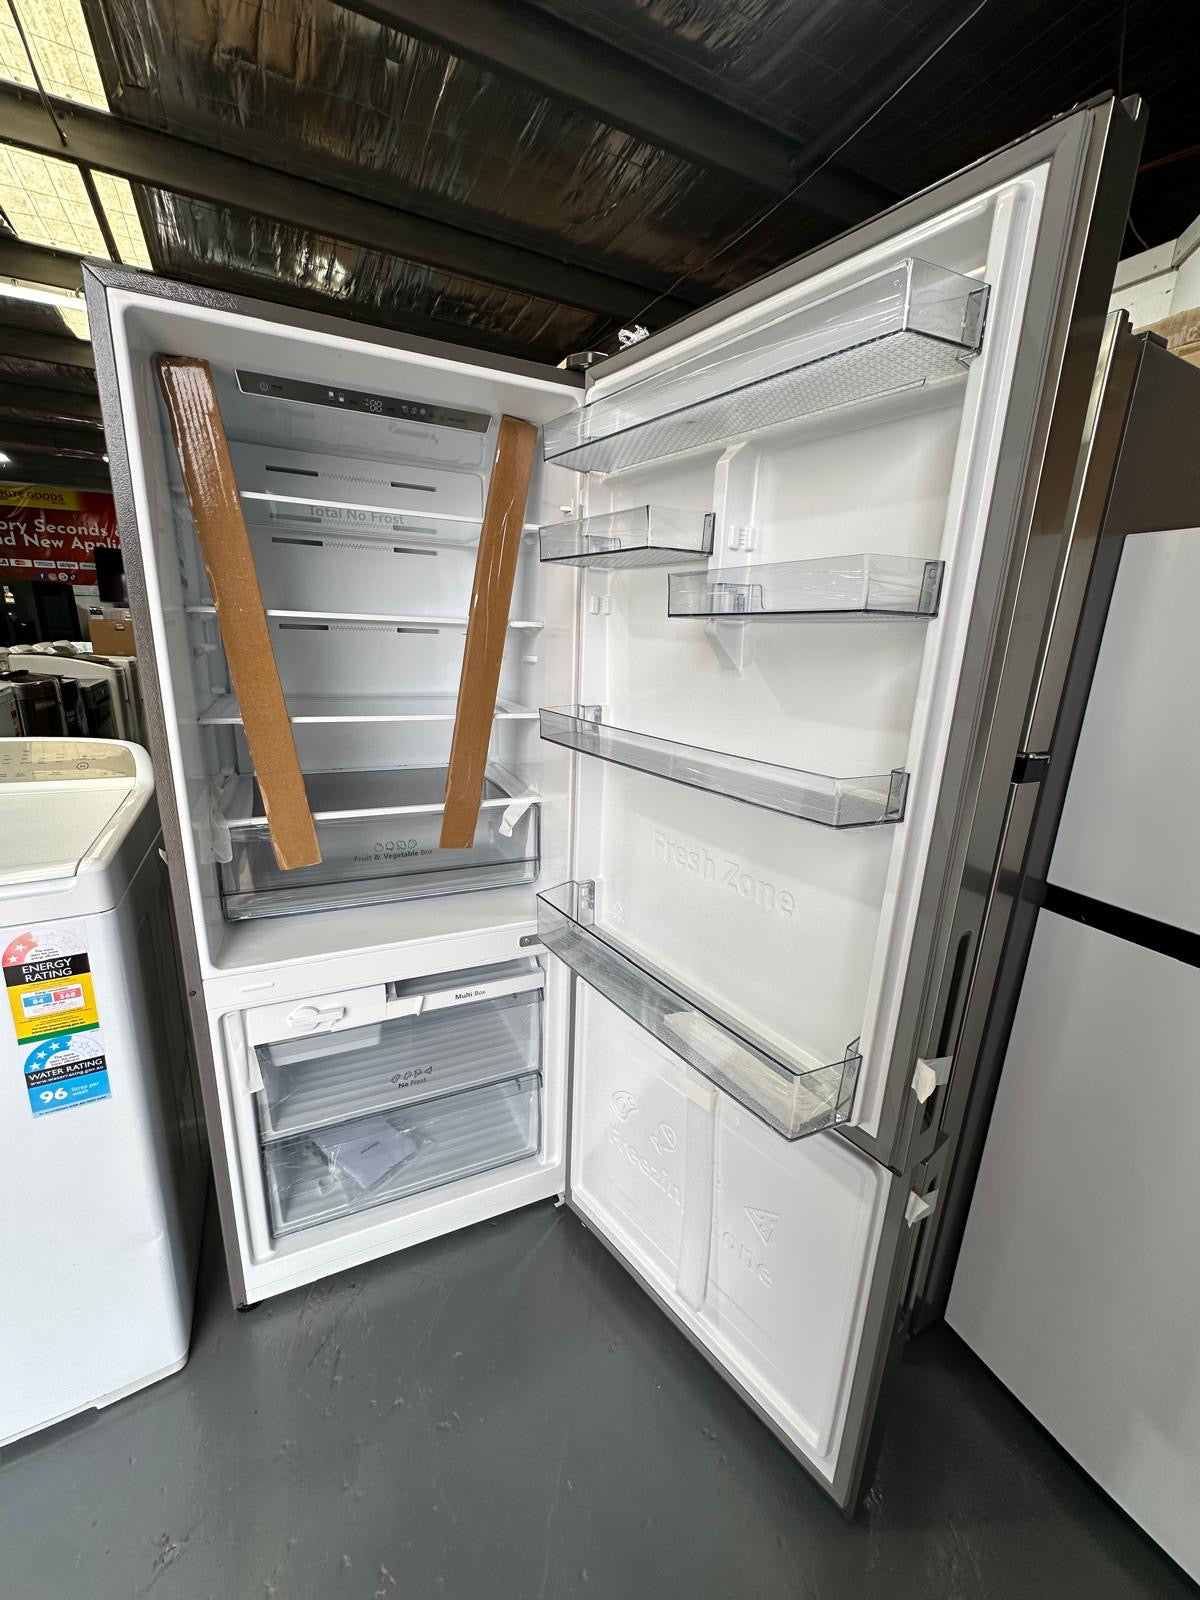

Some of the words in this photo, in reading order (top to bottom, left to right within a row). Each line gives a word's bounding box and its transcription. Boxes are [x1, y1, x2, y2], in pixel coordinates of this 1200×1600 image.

[27, 491, 65, 501] GOODS
[347, 508, 367, 521] No
[371, 511, 405, 524] Frost
[34, 519, 108, 537] Seconds
[23, 533, 64, 549] New
[383, 850, 419, 860] Vegetable
[650, 829, 716, 883] Fresh
[720, 858, 796, 917] Zone
[22, 957, 72, 974] ENERGY
[25, 967, 73, 983] RATING
[455, 991, 473, 1000] Multi
[28, 1068, 65, 1080] WATER
[66, 1058, 103, 1073] RATING
[410, 1078, 426, 1086] Frost
[40, 1087, 68, 1104] 96
[608, 1123, 687, 1216] Freezin
[720, 1230, 774, 1289] one
